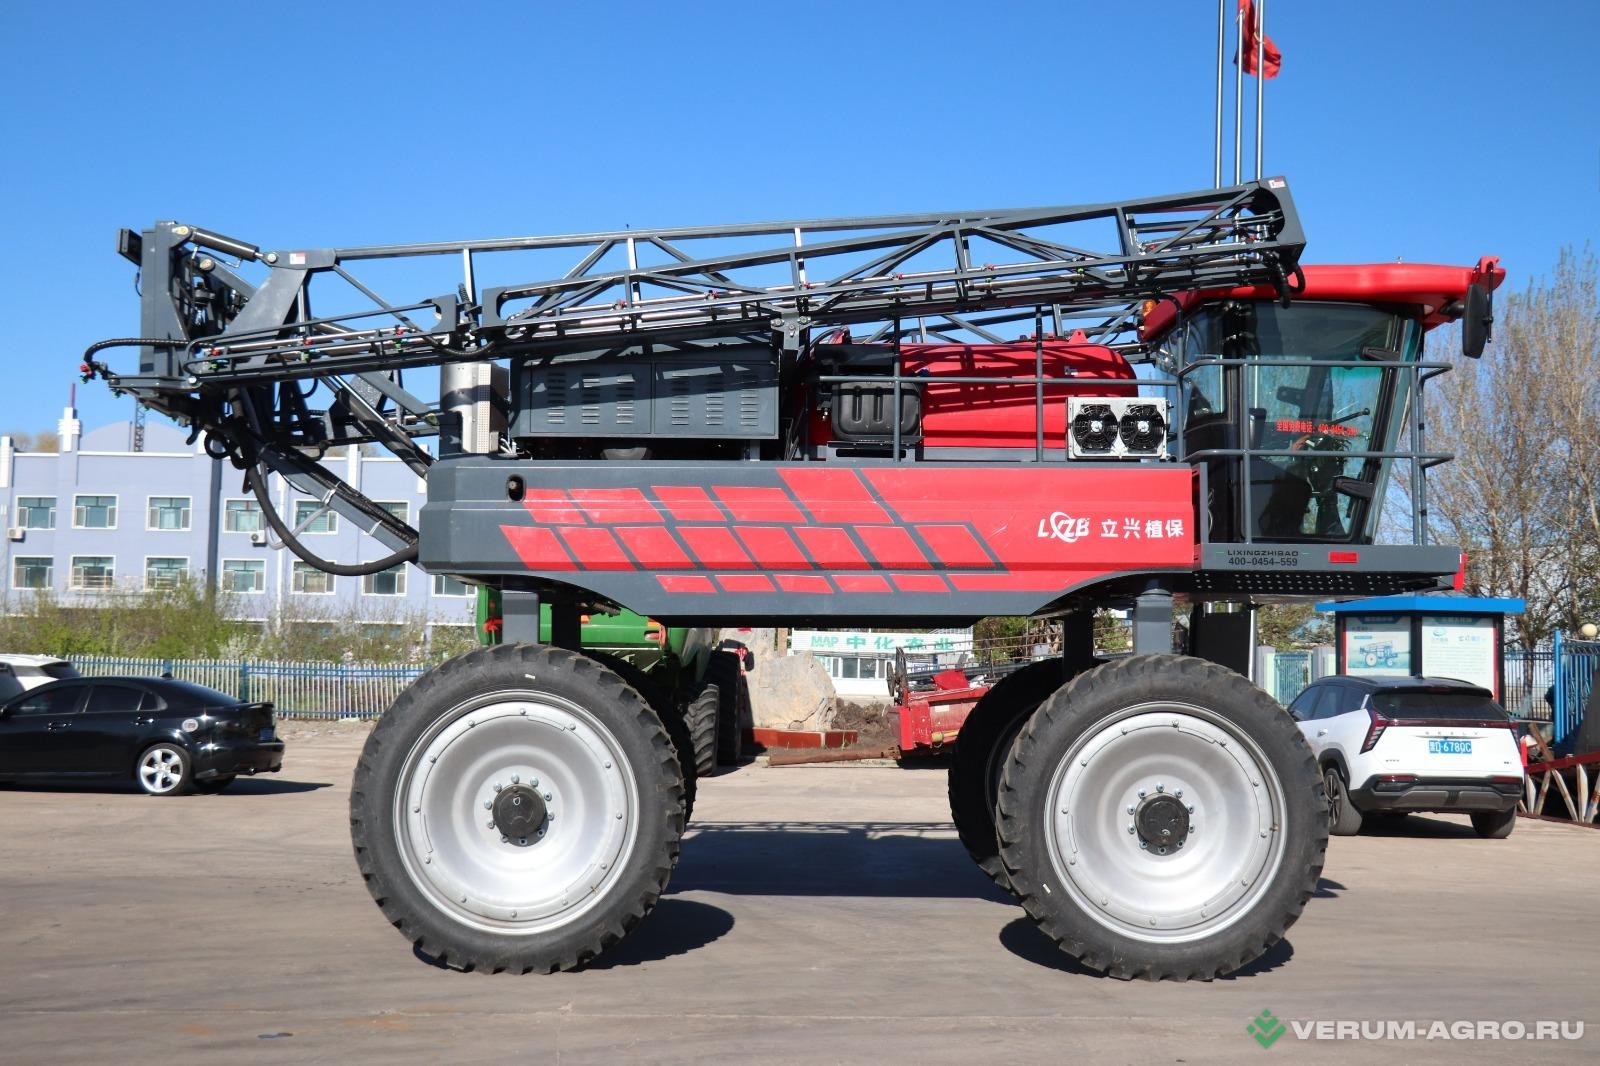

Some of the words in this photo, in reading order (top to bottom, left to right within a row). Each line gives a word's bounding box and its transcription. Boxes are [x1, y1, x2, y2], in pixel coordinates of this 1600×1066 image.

[1100, 517, 1184, 539] 立兴植保
[1228, 557, 1298, 567] 400-0454-559
[811, 635, 839, 647] MAP
